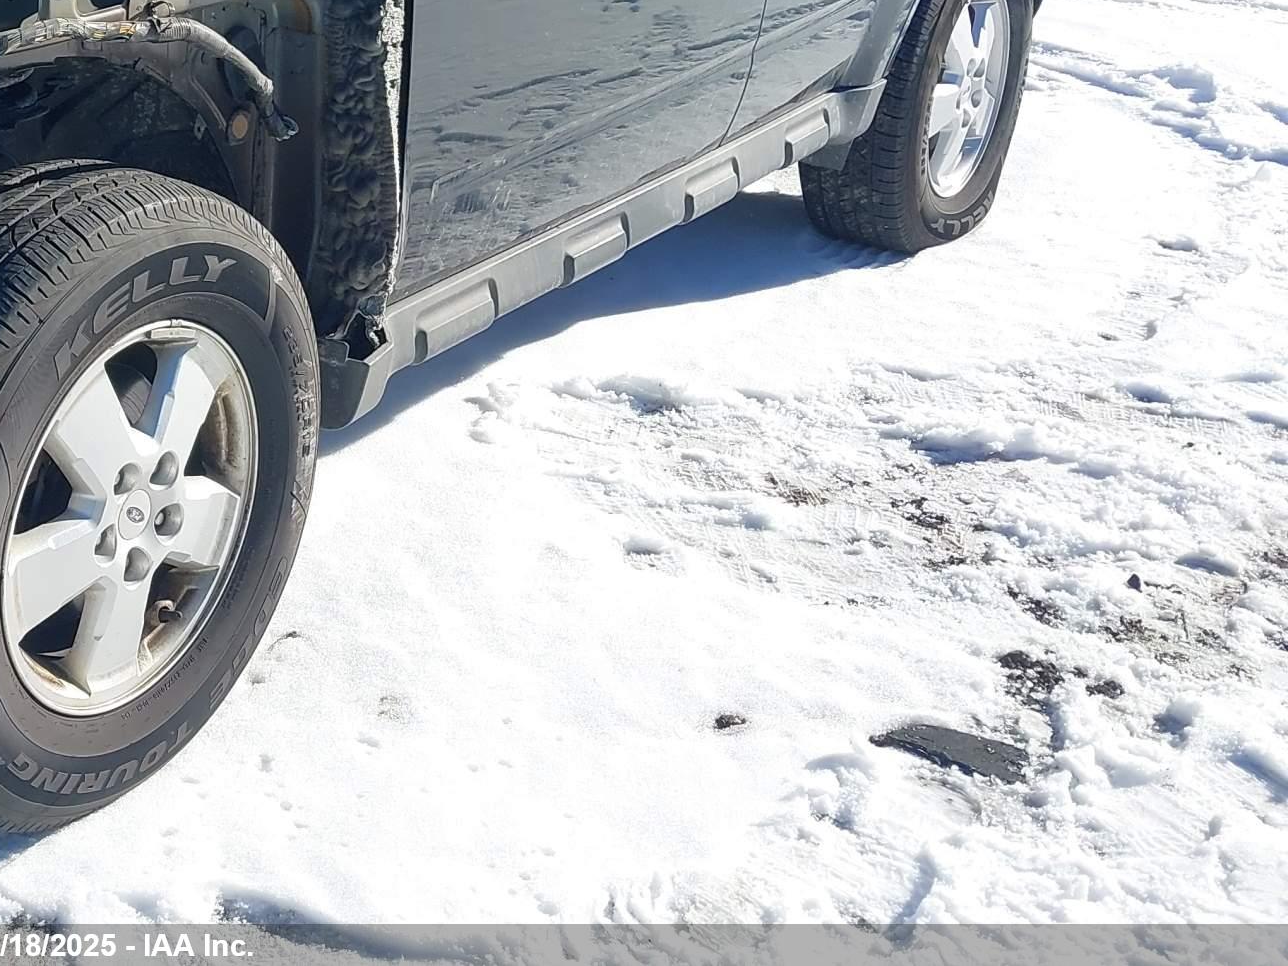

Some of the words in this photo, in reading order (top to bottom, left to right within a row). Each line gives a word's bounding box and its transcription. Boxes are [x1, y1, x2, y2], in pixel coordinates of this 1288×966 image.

[929, 190, 994, 235] KELLY
[53, 253, 238, 383] KELLY
[209, 556, 288, 713] EDGE
[6, 720, 193, 796] TOURING
